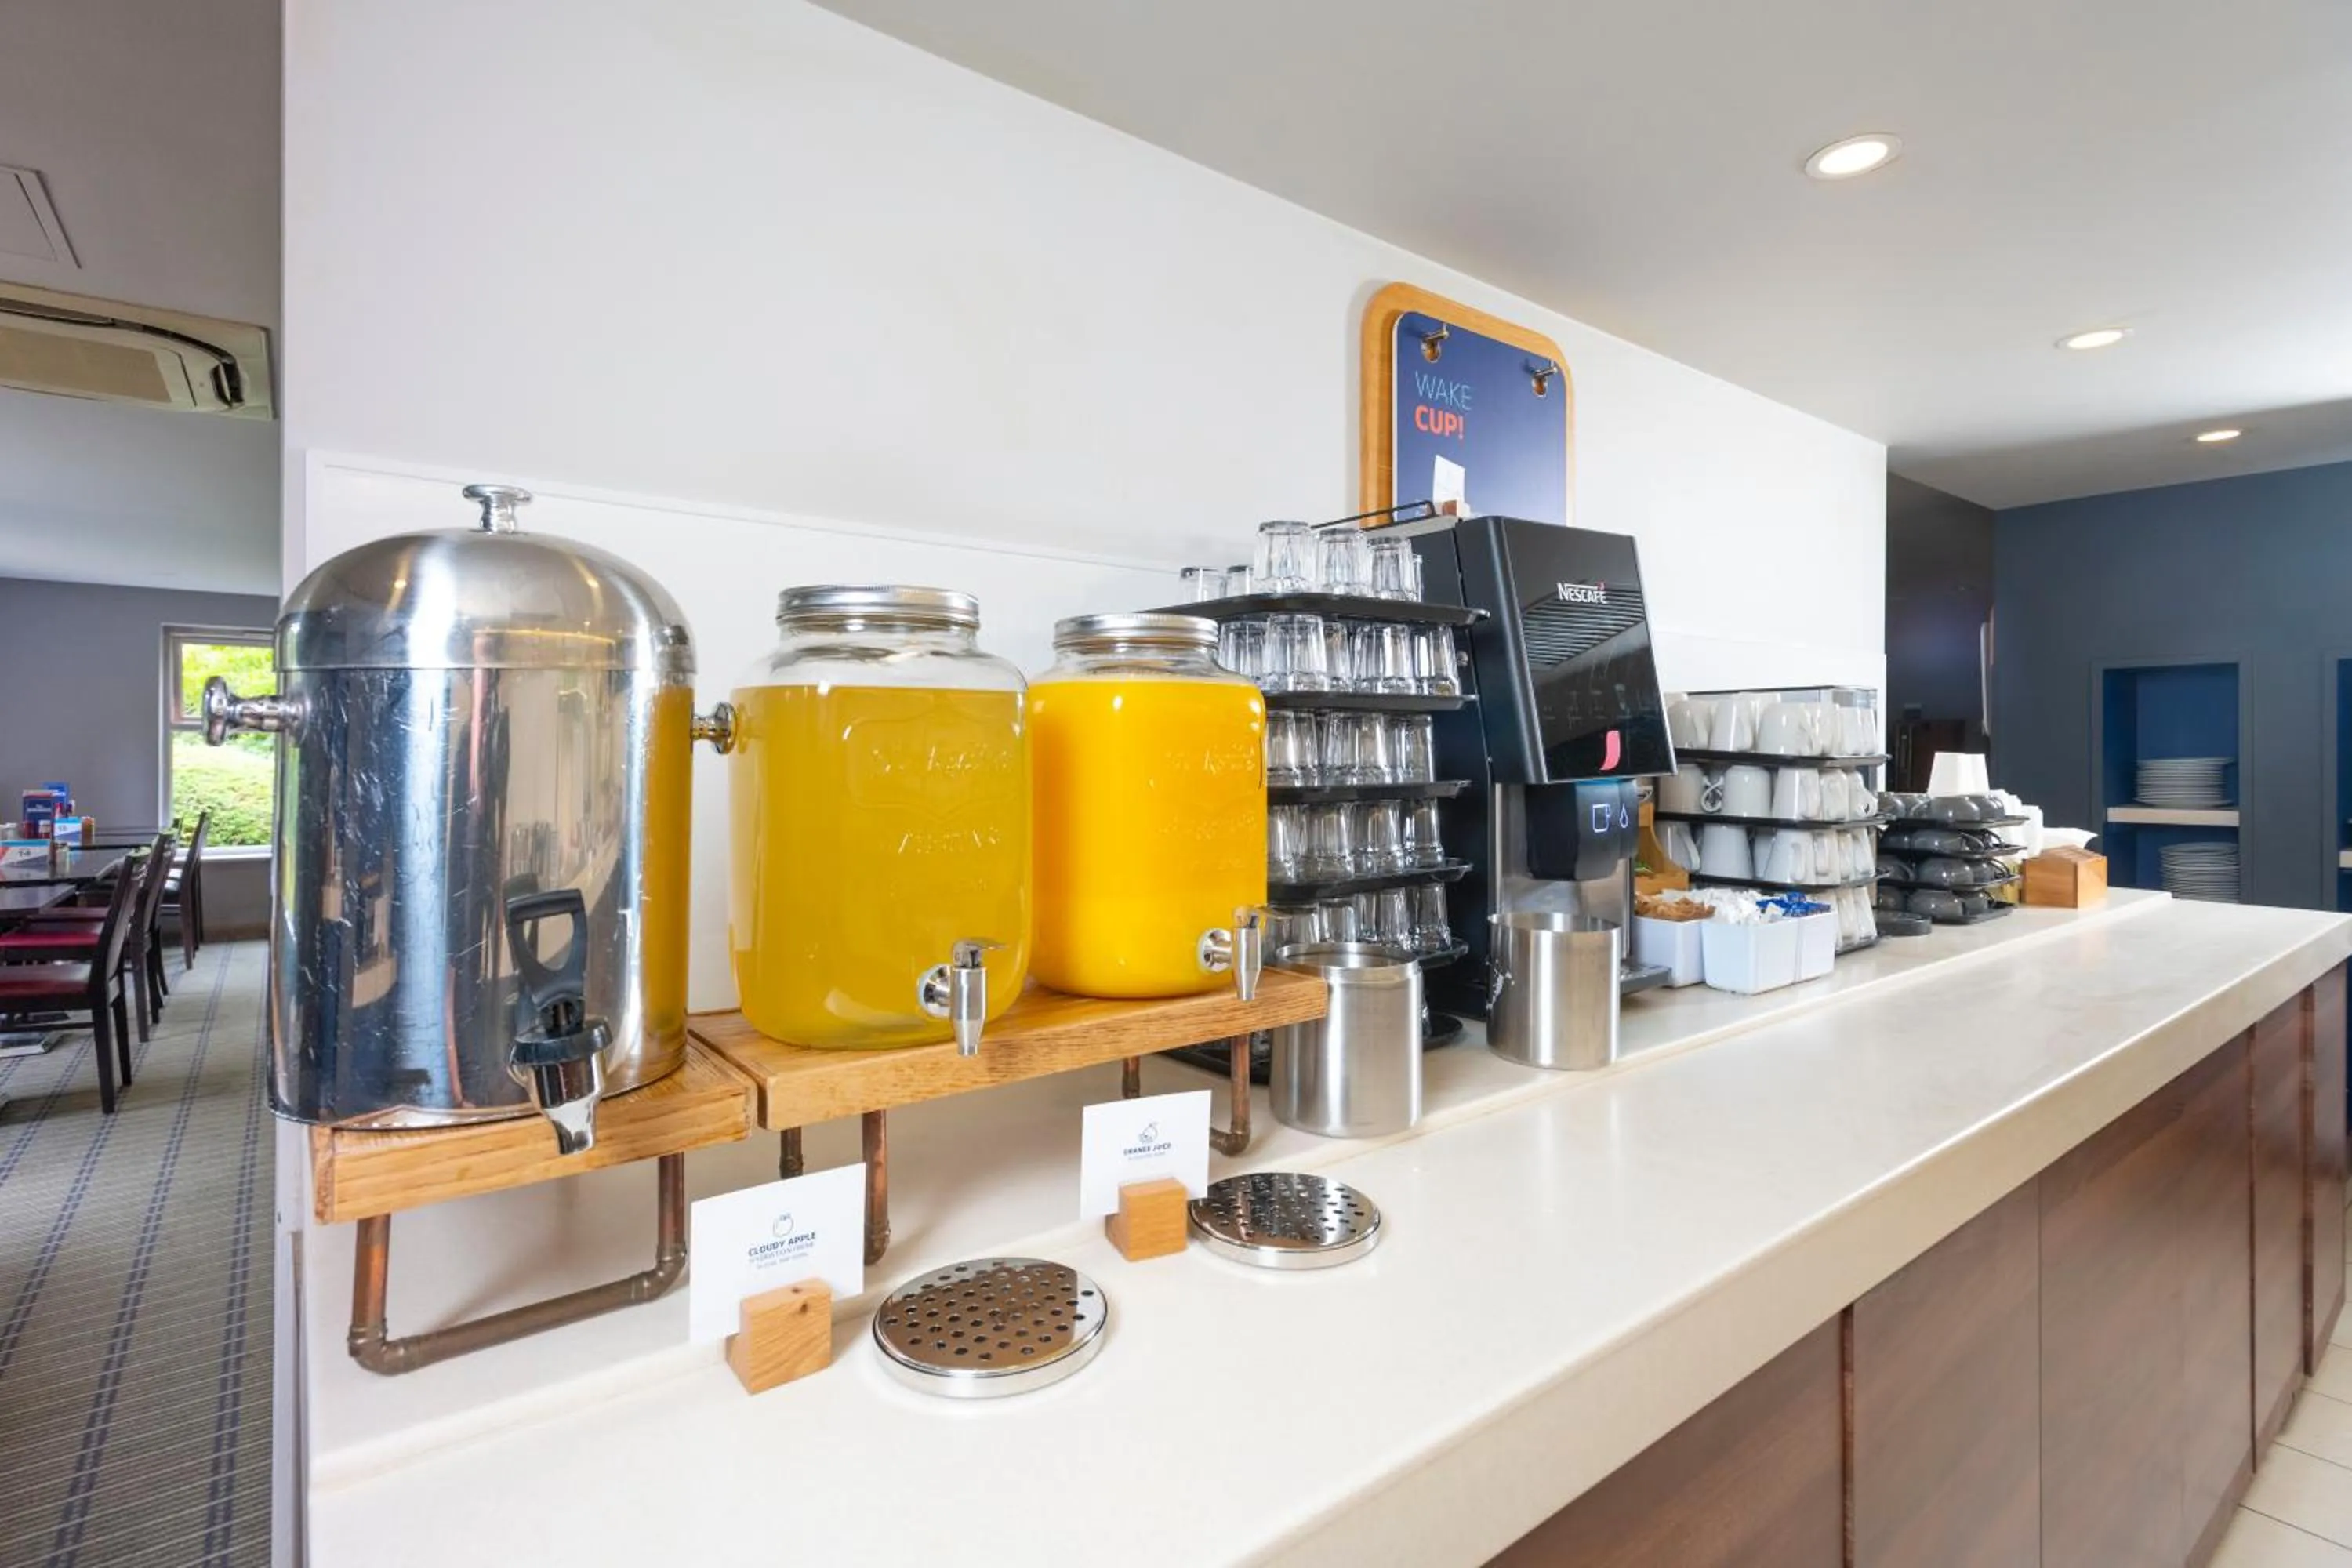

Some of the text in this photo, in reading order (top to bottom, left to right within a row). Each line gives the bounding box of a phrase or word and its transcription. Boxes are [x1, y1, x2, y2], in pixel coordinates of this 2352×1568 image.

[1414, 370, 1472, 411] WAKE
[1414, 404, 1465, 440] CUP!
[748, 1240, 786, 1257] CLOUDY
[787, 1232, 816, 1246] APPLE
